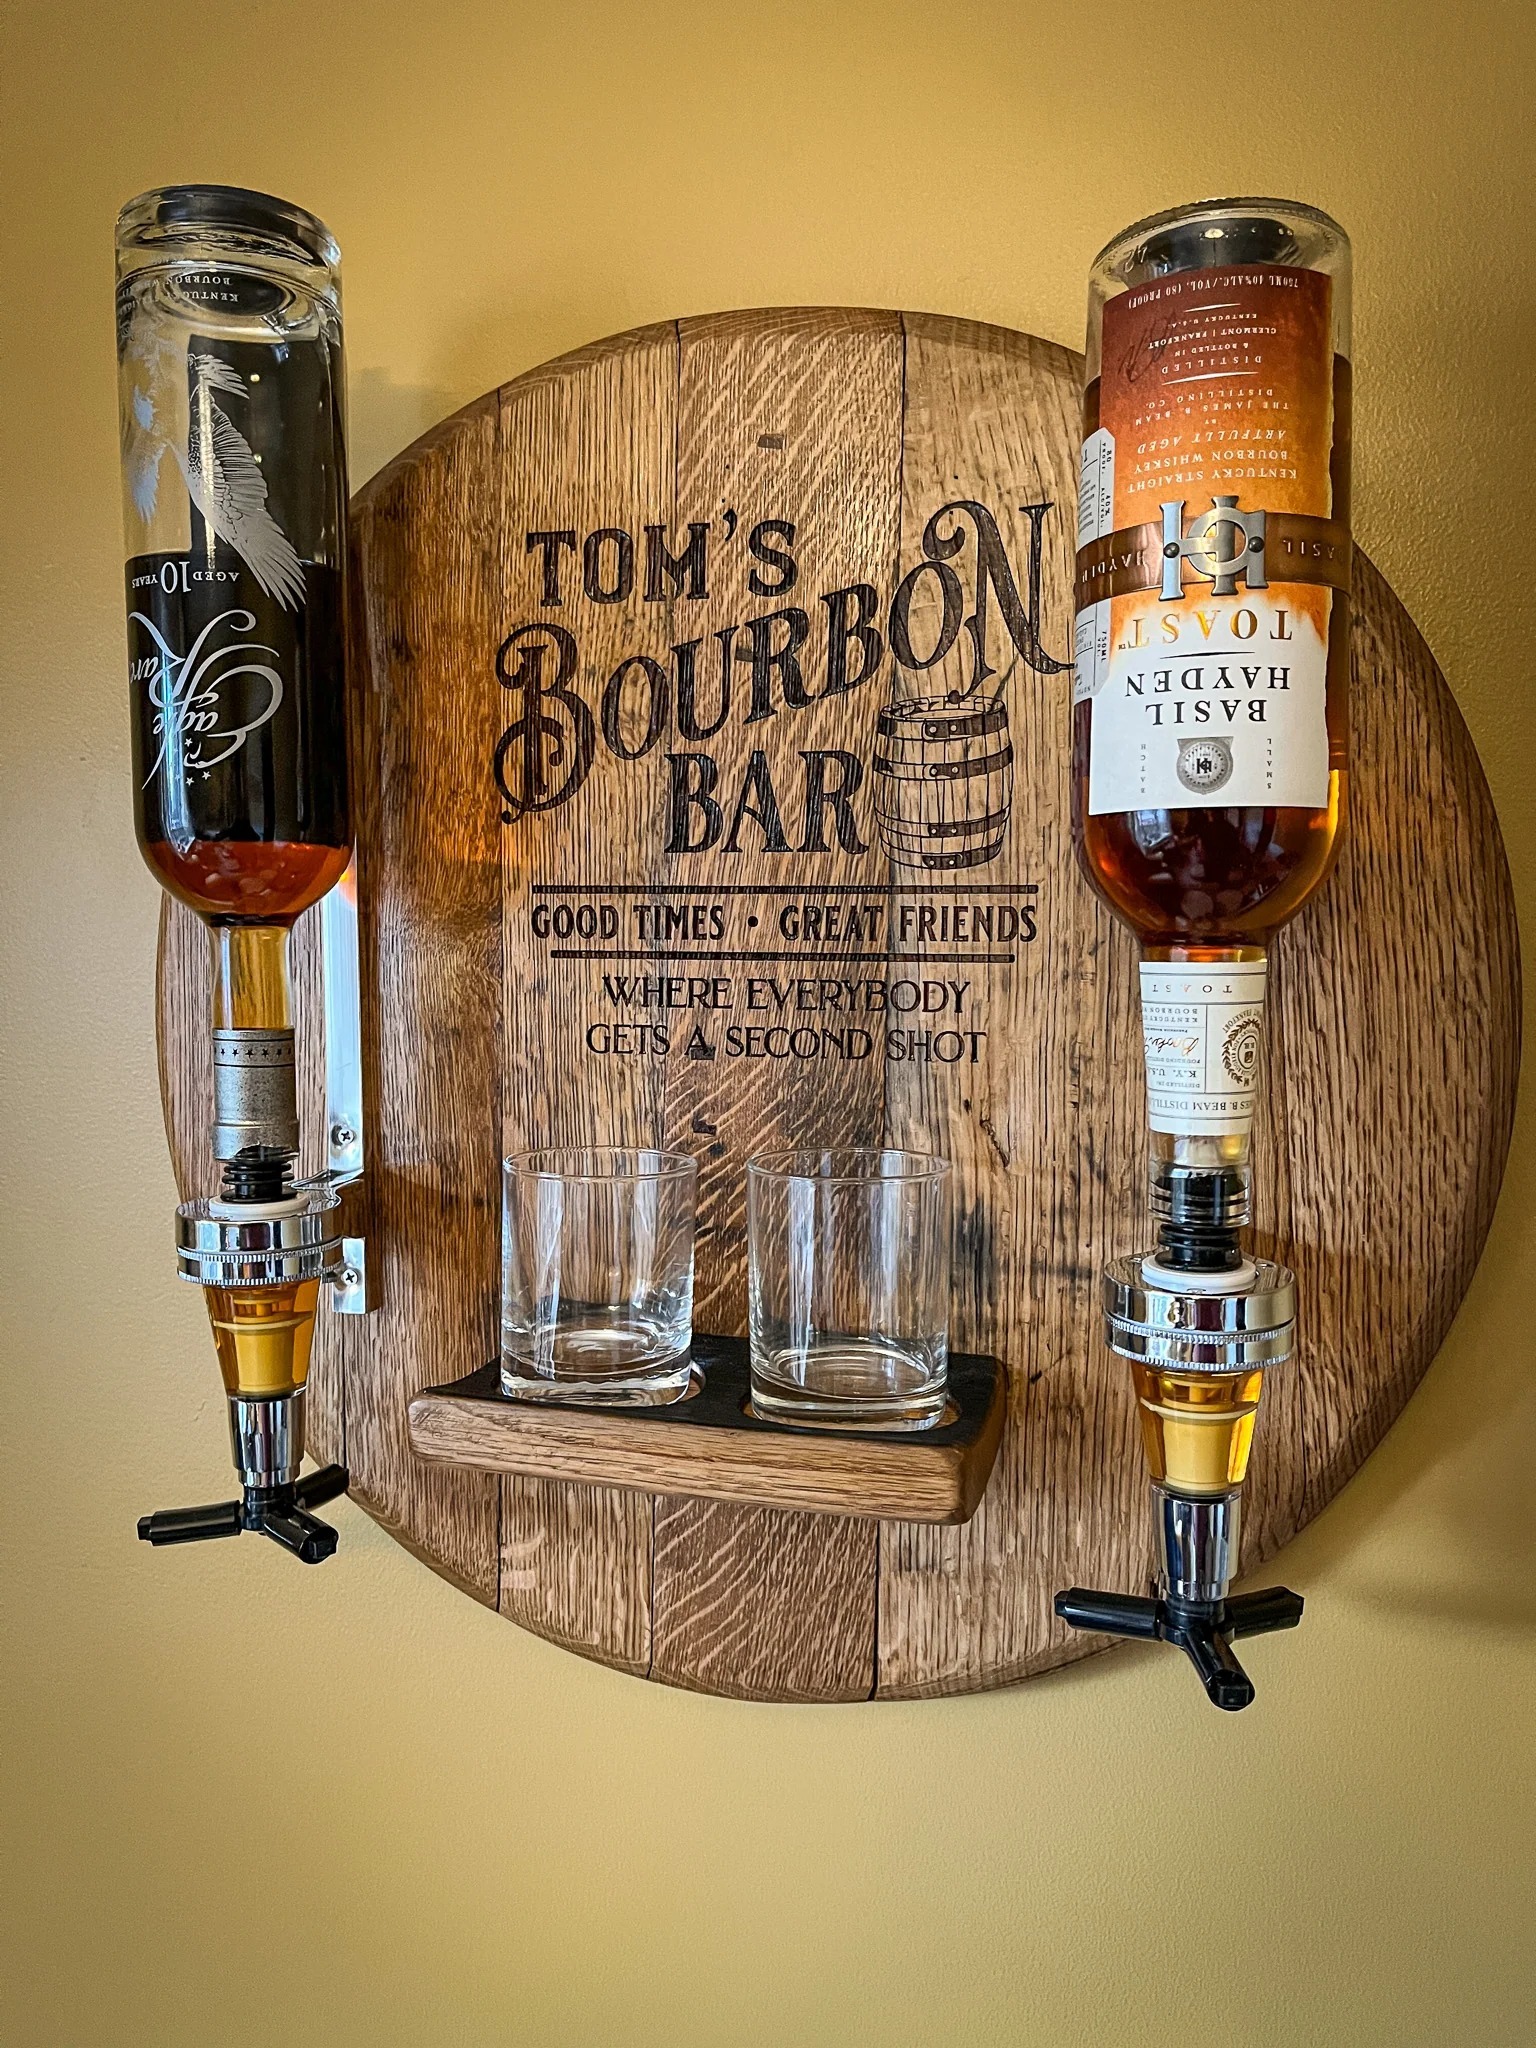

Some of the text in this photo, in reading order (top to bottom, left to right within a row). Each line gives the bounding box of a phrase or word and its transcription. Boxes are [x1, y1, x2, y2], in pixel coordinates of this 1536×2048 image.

[165, 274, 231, 285] BOURBON
[1269, 275, 1299, 288] 750ML
[1205, 313, 1258, 324] KENTUCKY
[1148, 327, 1278, 350] CLERMONT FRANKFORT
[1192, 342, 1231, 355] BOTTLED
[1161, 355, 1262, 375] DISTILLED
[1174, 349, 1187, 357] IN
[1176, 388, 1274, 404] DISTILLING
[1203, 400, 1252, 414] JAMES
[1263, 402, 1290, 411] THE
[1135, 409, 1172, 426] BEAM
[1204, 418, 1217, 426] BY
[1137, 429, 1287, 455] ARTFULLY AGED
[1134, 449, 1289, 475] BOURBON WHISKEY
[1127, 467, 1298, 494] KENTUCKY STRAIGHT
[526, 507, 797, 607] TOM'S
[132, 561, 240, 594] AGED 10 YEARS
[494, 500, 1075, 825] BOURBON
[1125, 665, 1291, 697] HAYDEN
[141, 644, 284, 790] Eagle
[1145, 699, 1268, 726] BASIL
[1139, 744, 1147, 794] BATCH
[1266, 738, 1274, 790] SMALL
[664, 750, 870, 855] BAR
[531, 903, 1038, 943] GOOD TIMES GREAT FRIENDS
[602, 976, 971, 1014] WHERE EVERYBODY
[1151, 984, 1233, 994] TOAST
[585, 1023, 987, 1064] GETS A SECOND SHOT
[1193, 1101, 1227, 1111] BEAM
[1228, 1100, 1238, 1111] B.
